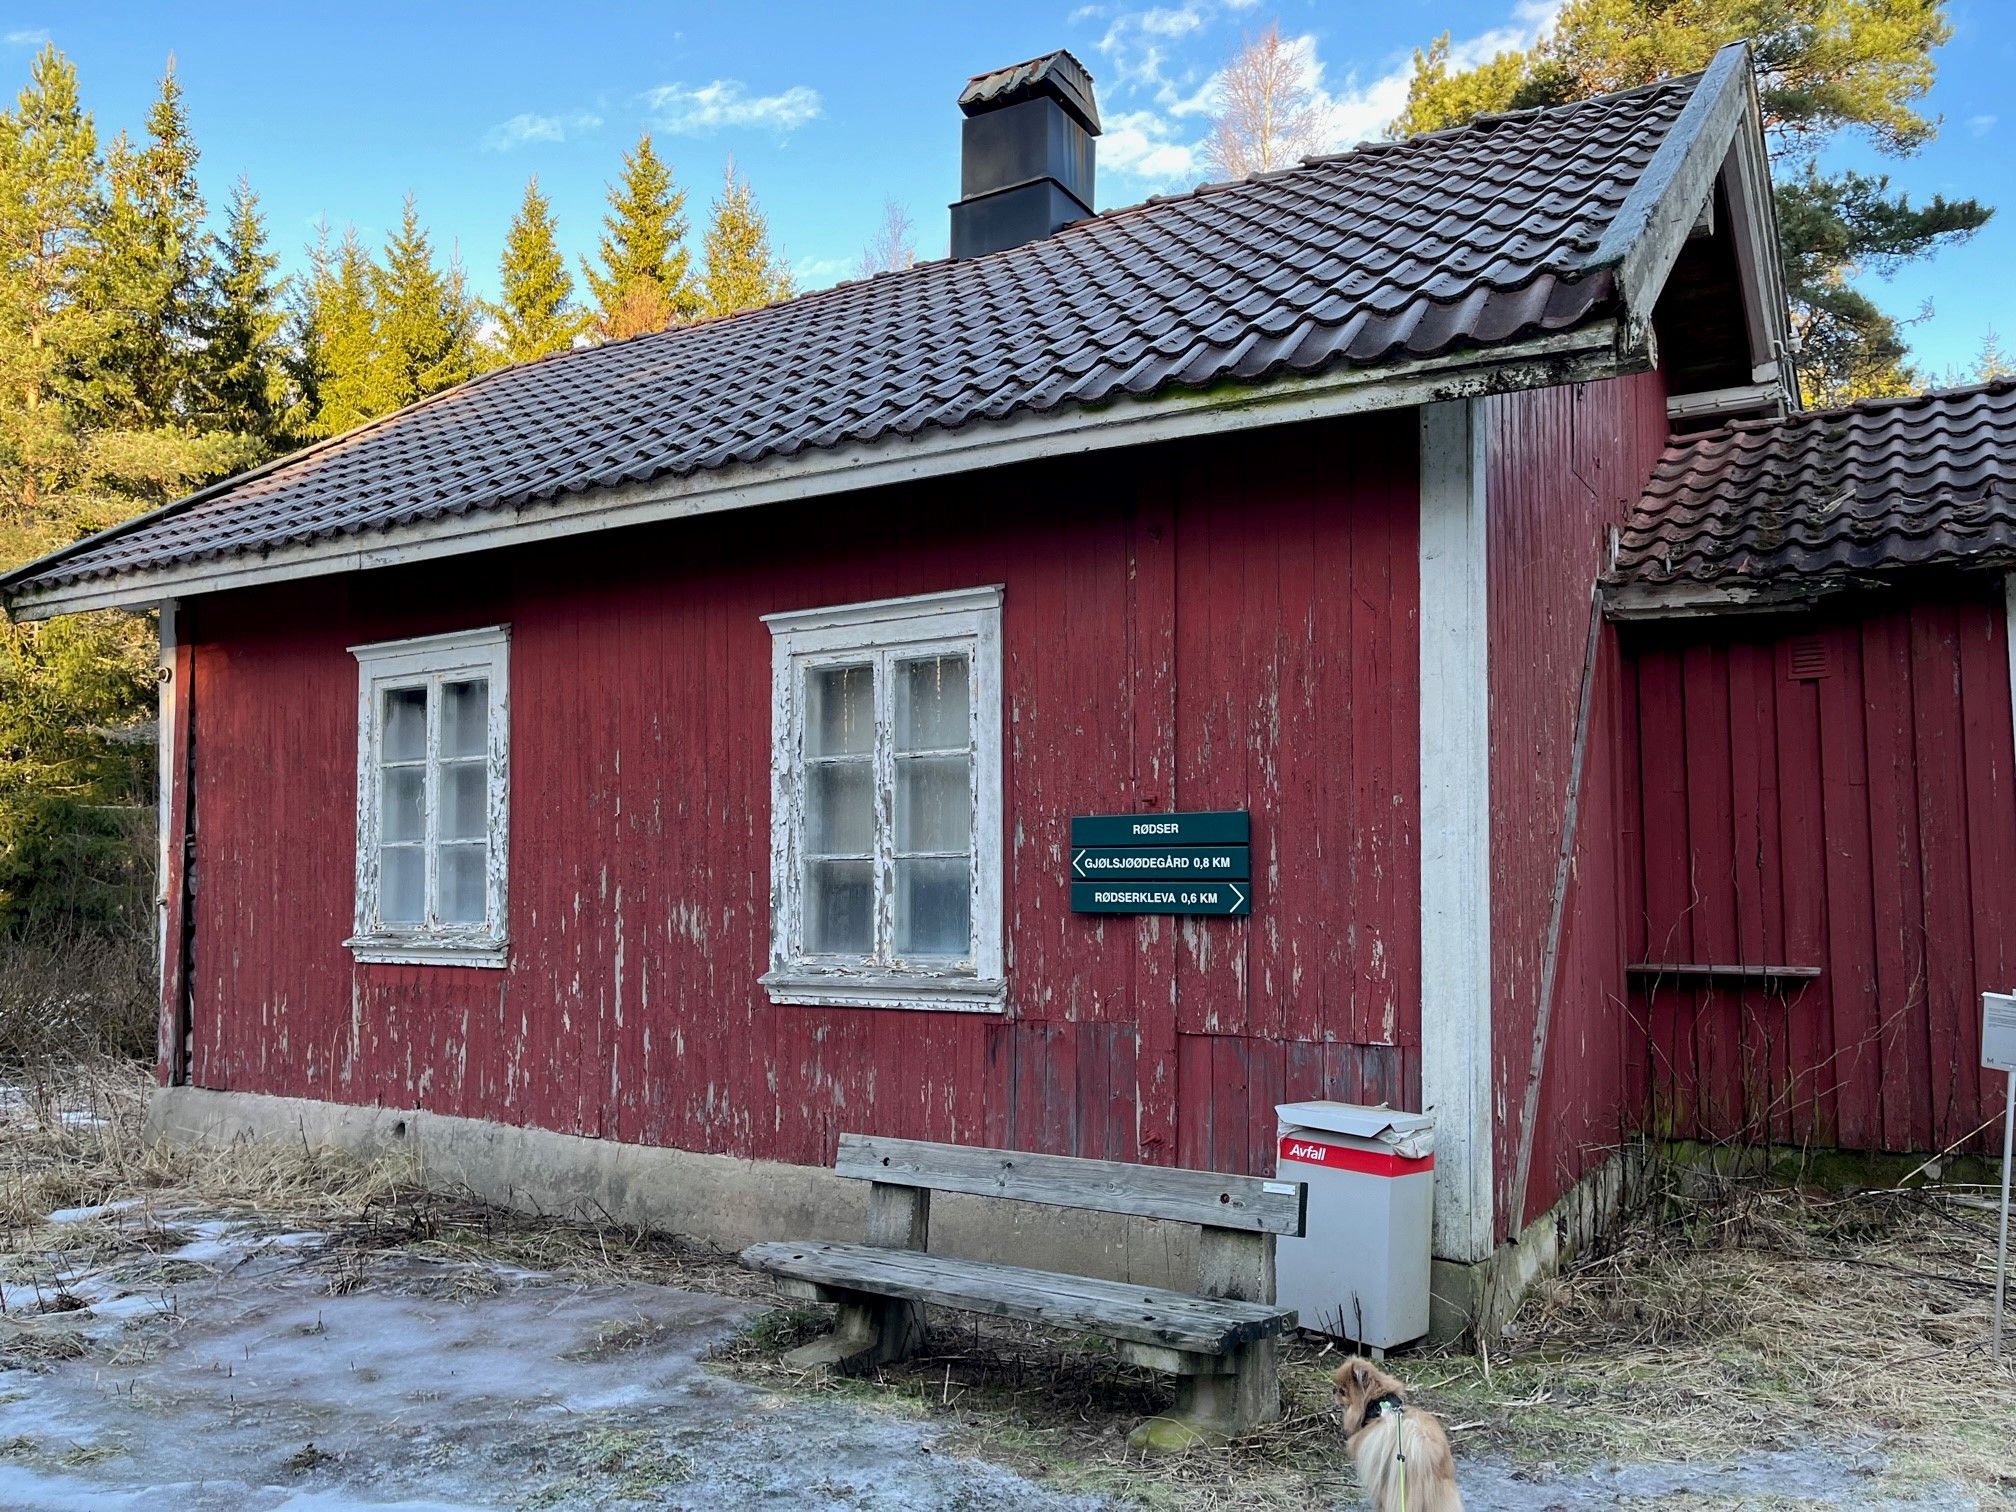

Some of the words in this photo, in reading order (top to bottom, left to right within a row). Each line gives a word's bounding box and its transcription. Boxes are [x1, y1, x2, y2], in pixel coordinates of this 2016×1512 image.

[1133, 824, 1179, 834] RØDSER
[1084, 855, 1190, 868] GJØLSJØØDEGÅRD
[1193, 858, 1210, 870] 0,8
[1212, 857, 1231, 868] KM
[1094, 892, 1176, 903] RØDSERKLEVA
[1181, 894, 1197, 905] 0,6
[1200, 893, 1218, 903] KM
[1289, 1143, 1326, 1161] Avfall
